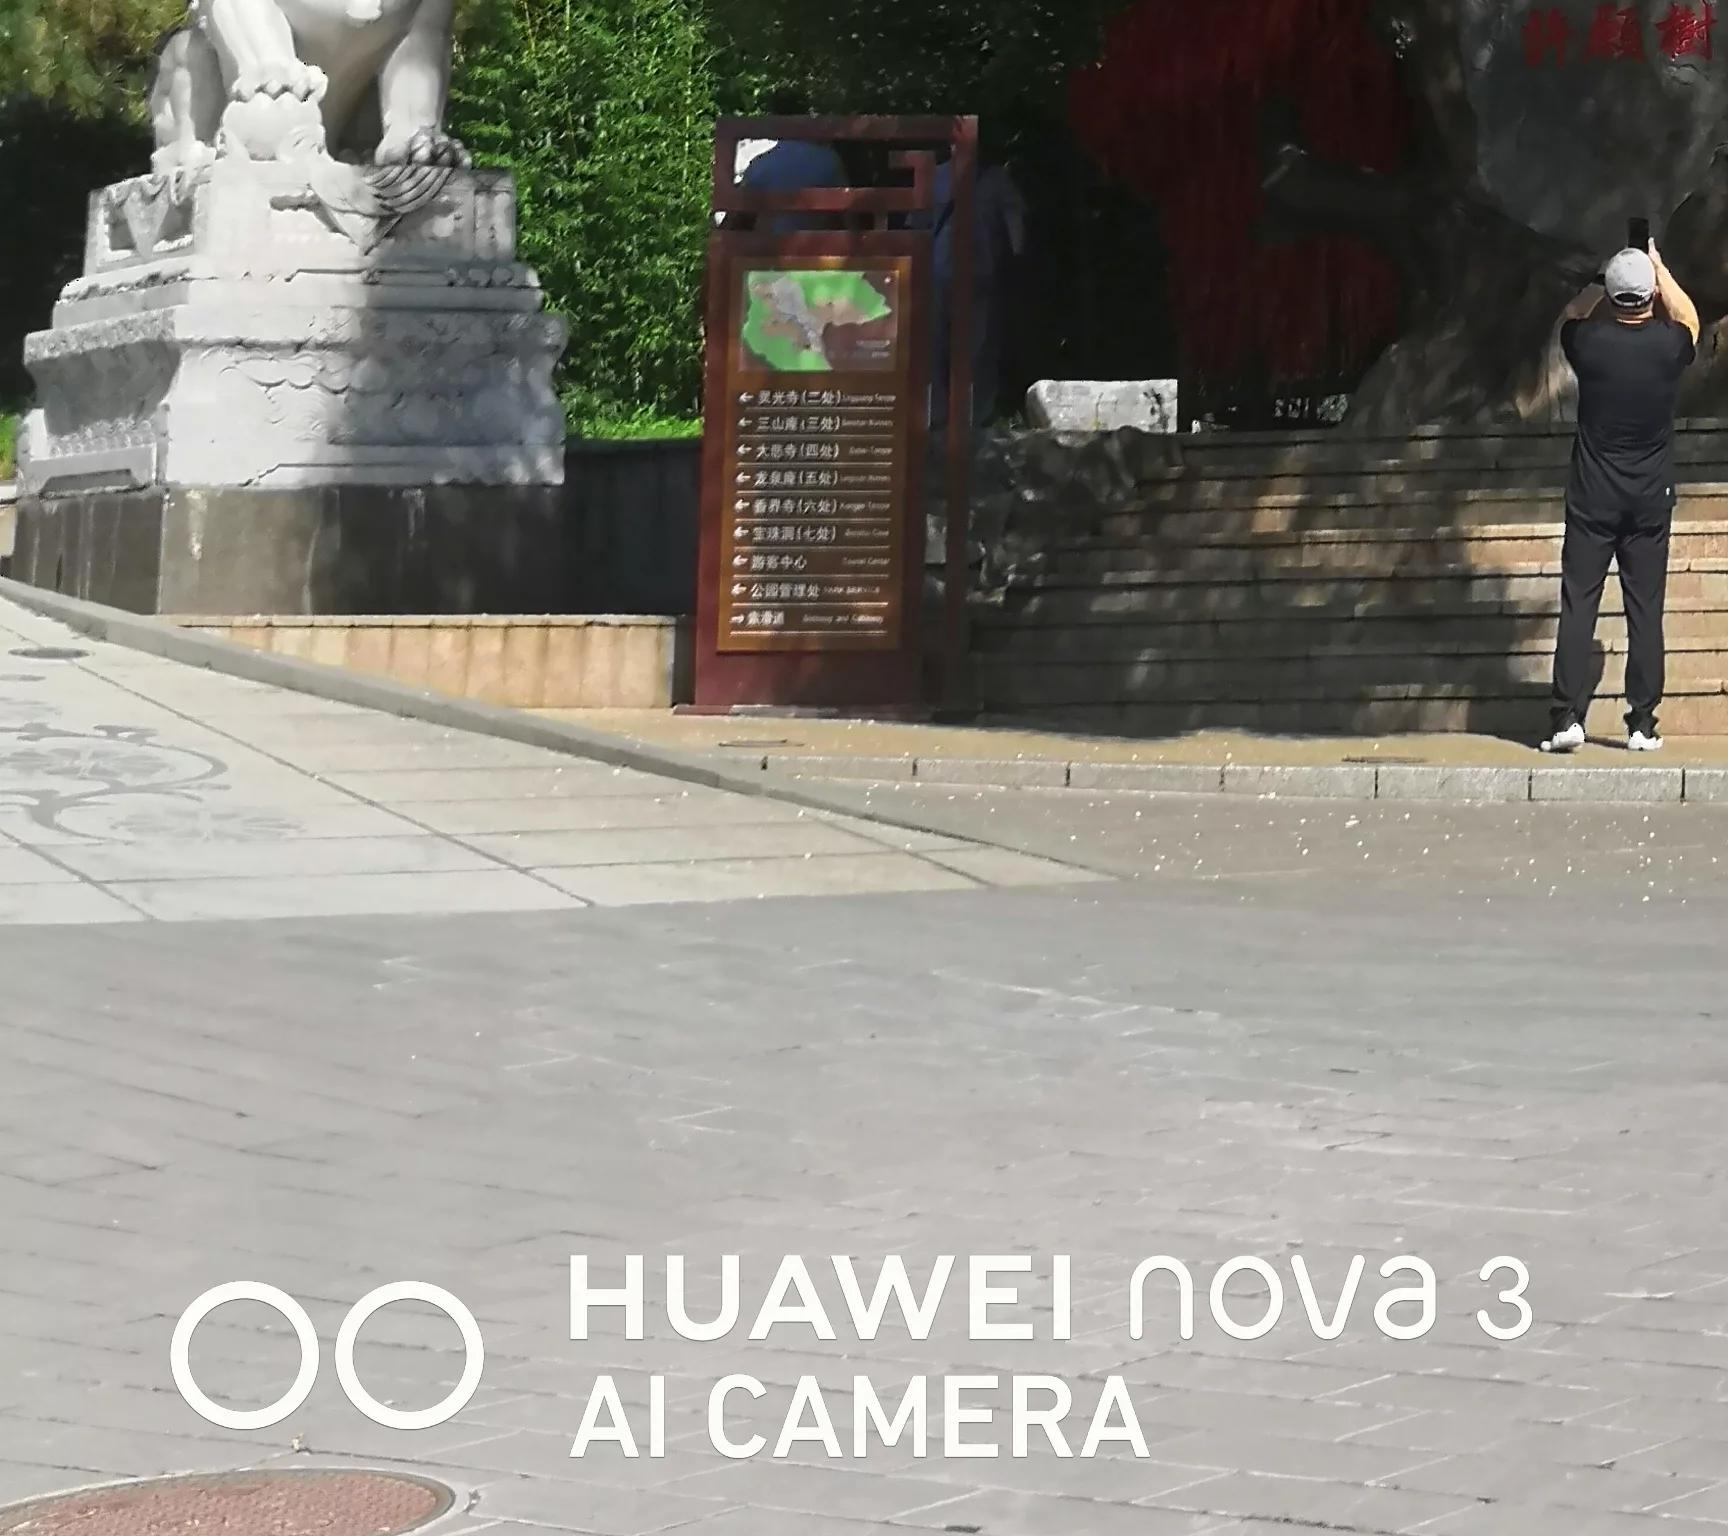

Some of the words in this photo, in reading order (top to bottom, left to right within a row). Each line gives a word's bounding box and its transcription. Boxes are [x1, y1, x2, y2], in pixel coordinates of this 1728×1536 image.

[750, 554, 808, 570] 游客中心
[750, 583, 820, 599] 公园管理处
